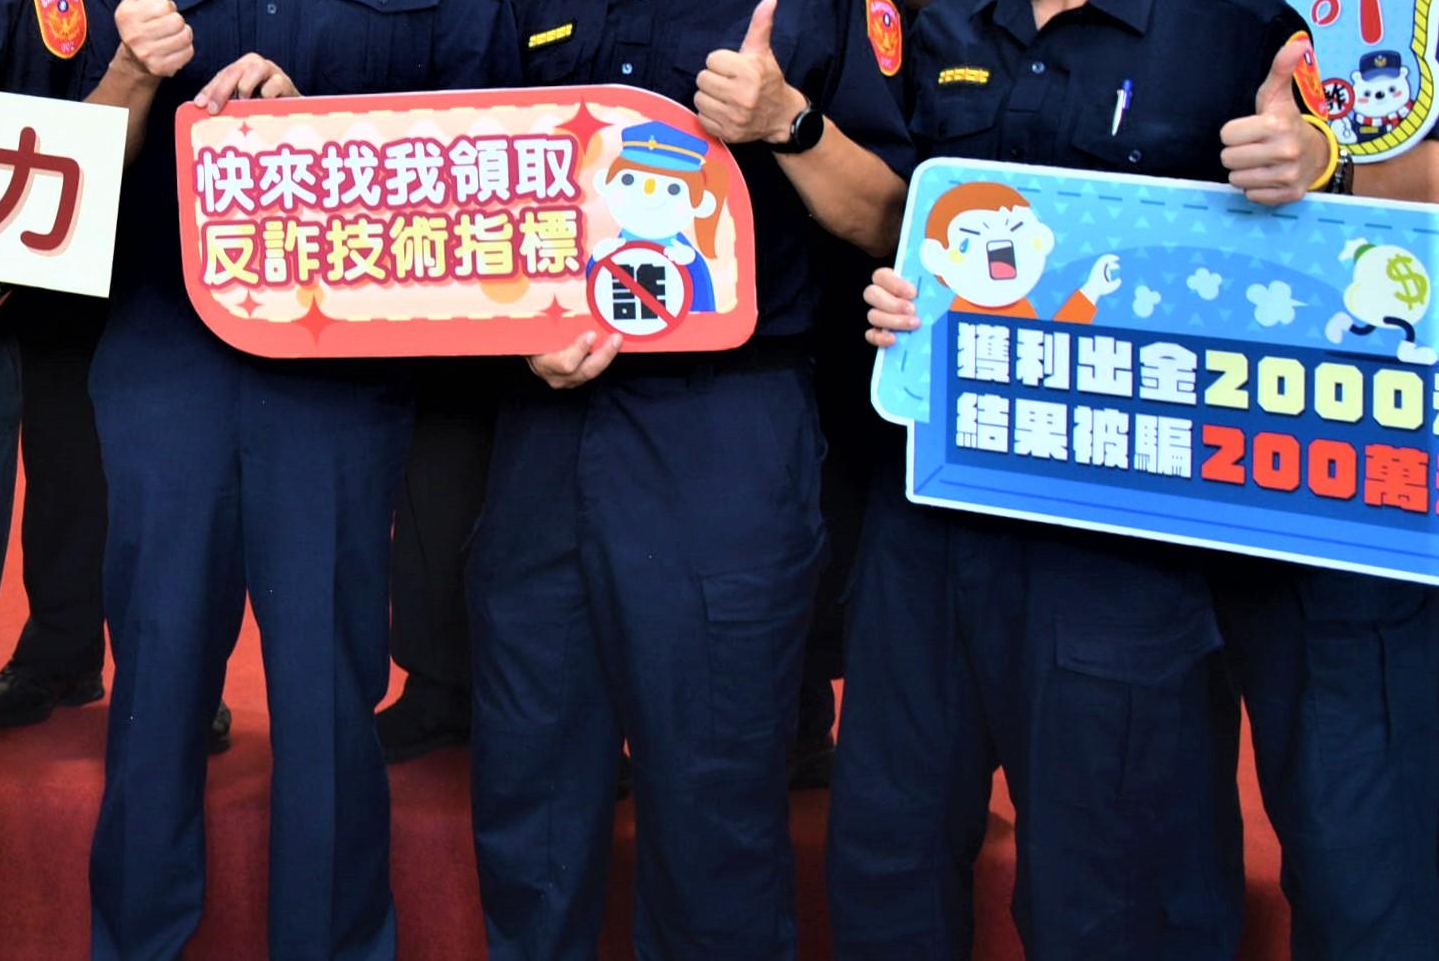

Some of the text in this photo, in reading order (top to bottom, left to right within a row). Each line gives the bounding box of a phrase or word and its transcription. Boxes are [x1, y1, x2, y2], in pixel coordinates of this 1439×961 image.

[196, 137, 576, 213] 快來找我領取
[202, 210, 582, 287] 反詐技術指標
[957, 322, 1439, 436] 獲利出金2000
[955, 392, 1439, 515] 結果被騙200萬
